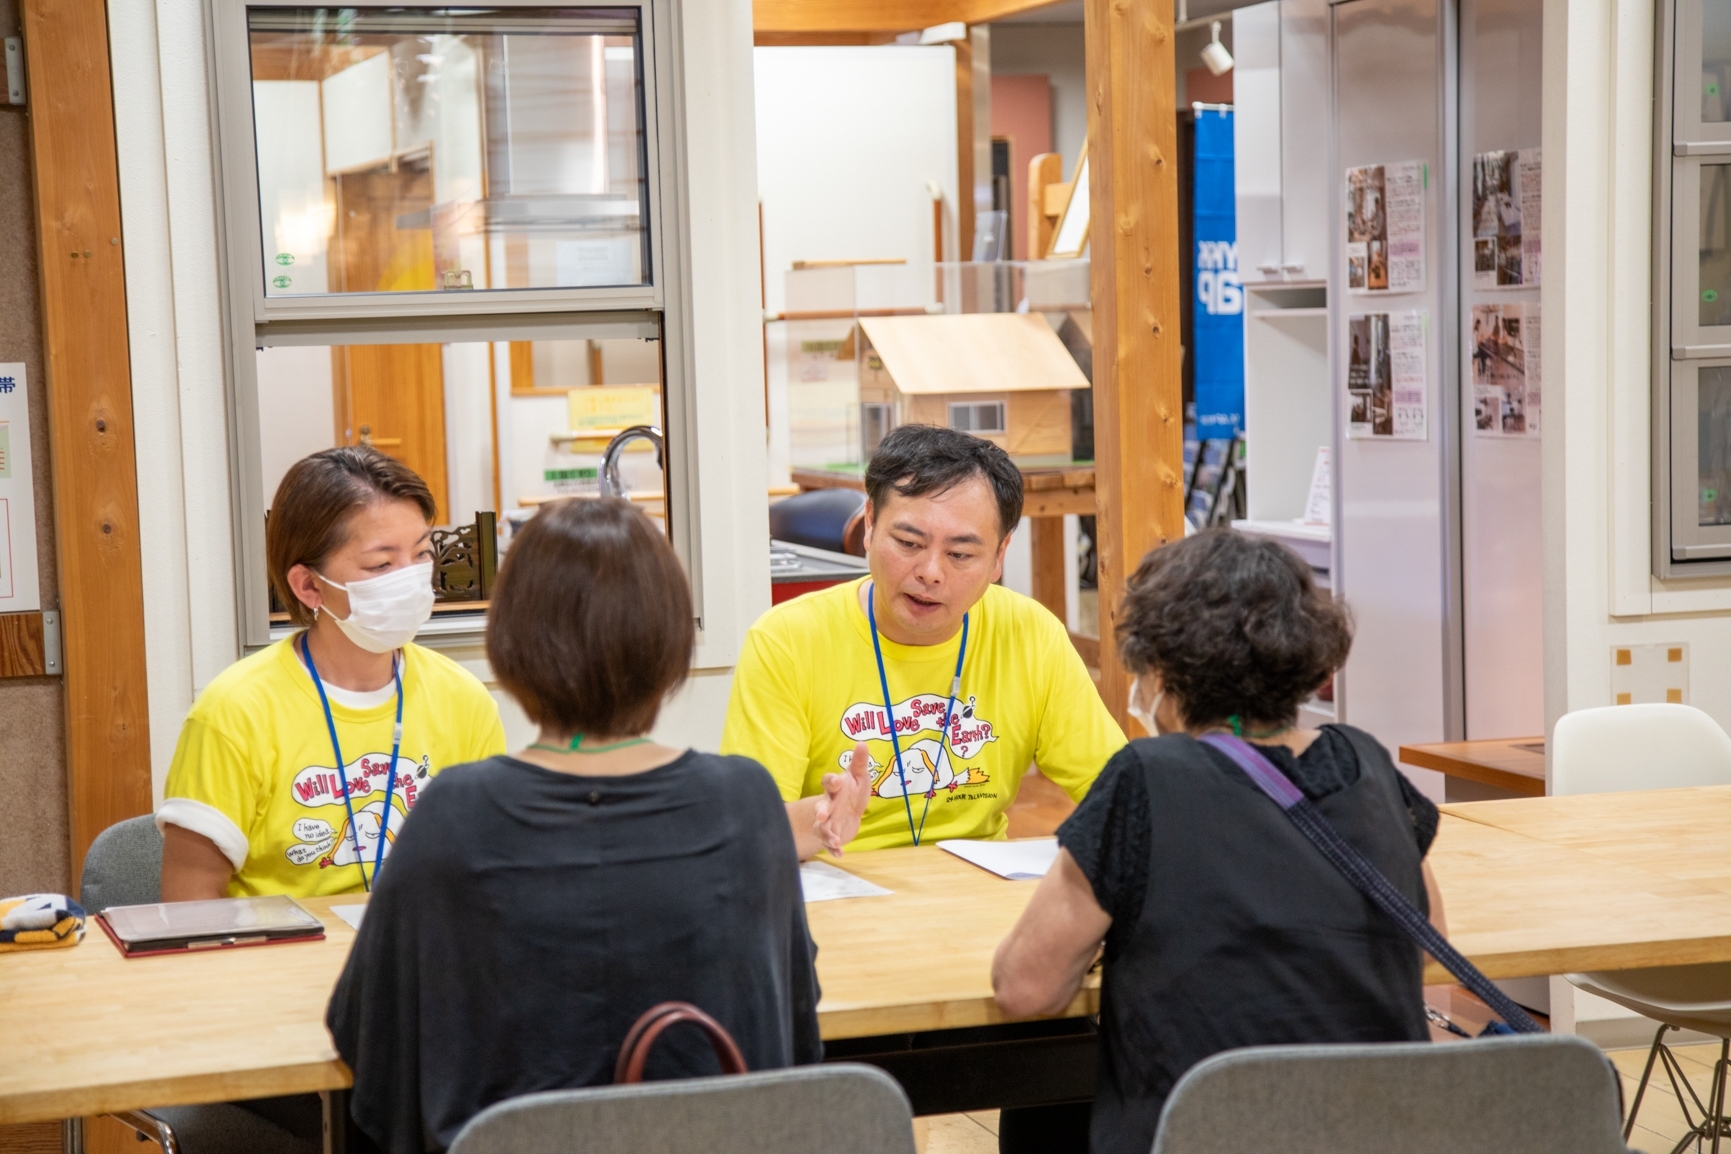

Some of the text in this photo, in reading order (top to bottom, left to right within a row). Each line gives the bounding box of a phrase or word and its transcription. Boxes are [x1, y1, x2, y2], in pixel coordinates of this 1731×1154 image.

[844, 710, 876, 736] Will
[876, 711, 920, 736] Love
[910, 699, 946, 718] Save
[951, 724, 991, 746] Earth?
[294, 774, 330, 802] Will
[329, 774, 371, 800] Love
[360, 758, 392, 779] Sav
[304, 823, 320, 832] have
[296, 855, 305, 863] do
[304, 851, 316, 861] you
